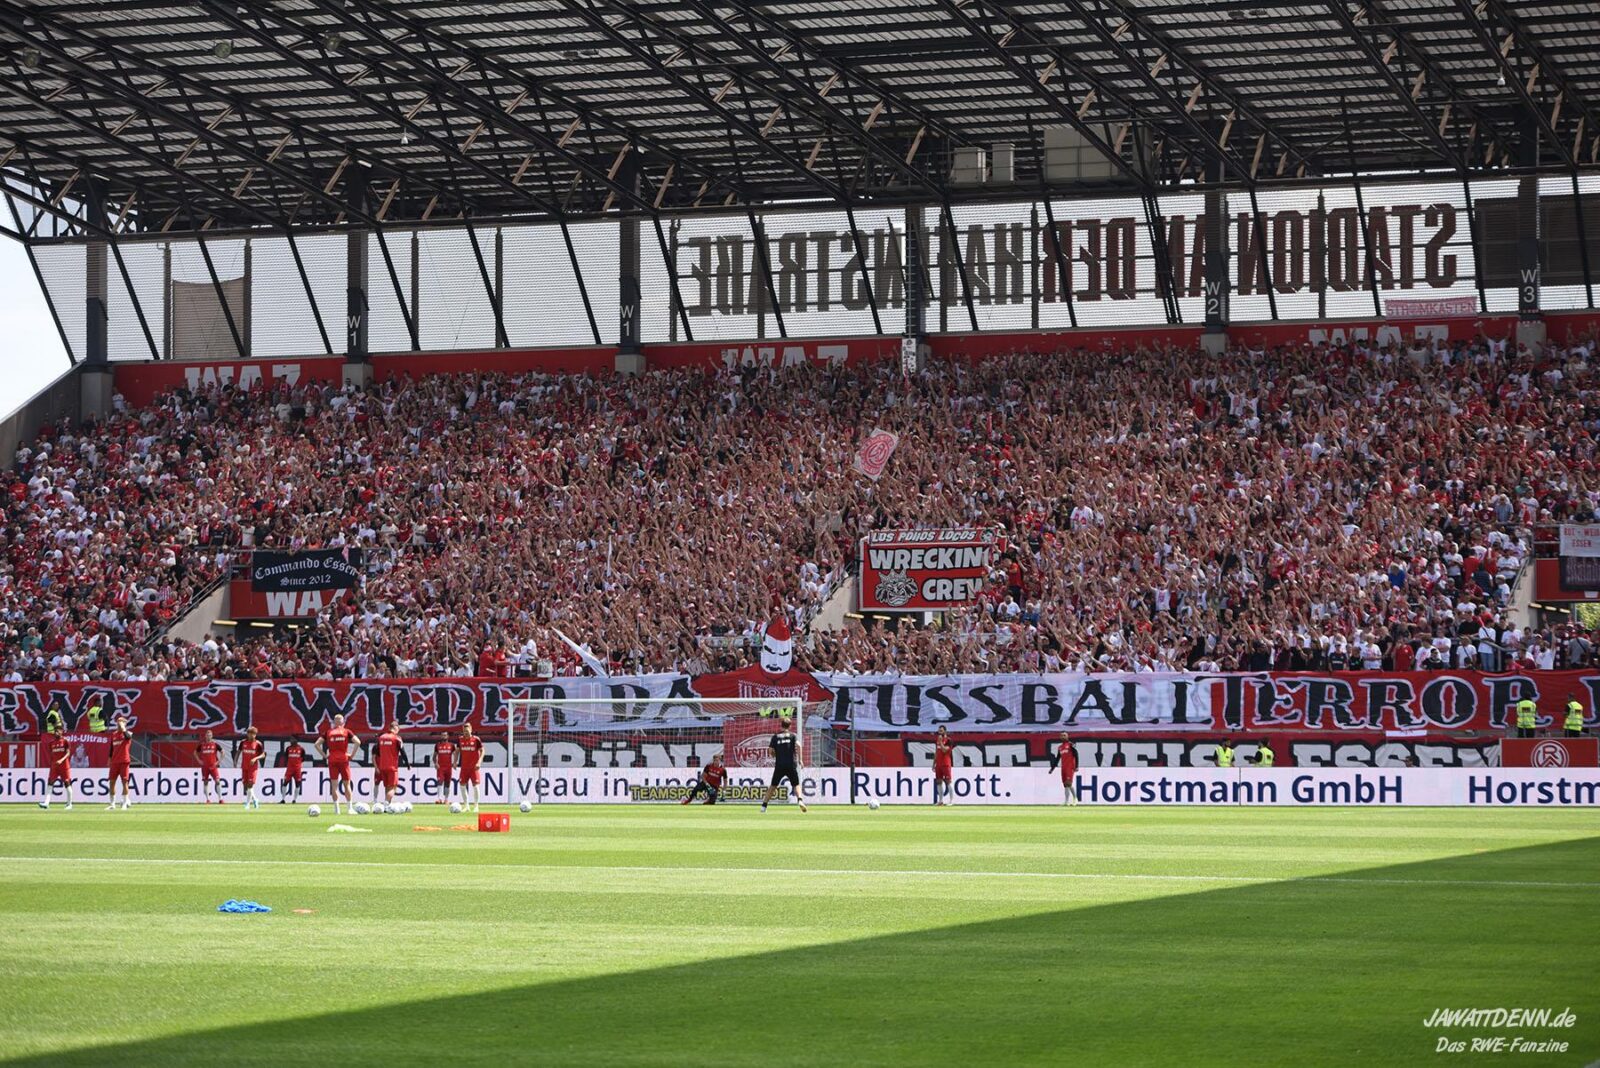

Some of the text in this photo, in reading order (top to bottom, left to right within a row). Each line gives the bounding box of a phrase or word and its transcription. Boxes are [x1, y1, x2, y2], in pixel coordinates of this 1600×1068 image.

[255, 556, 357, 580] Commando Essen
[309, 574, 331, 586] 2012
[0, 683, 142, 735] RWE
[162, 679, 273, 731] IST
[277, 682, 579, 735] WIEDER
[603, 771, 628, 796] in
[850, 771, 1011, 803] Ruhrpott.
[1077, 774, 1402, 802] Horstmann GmbH
